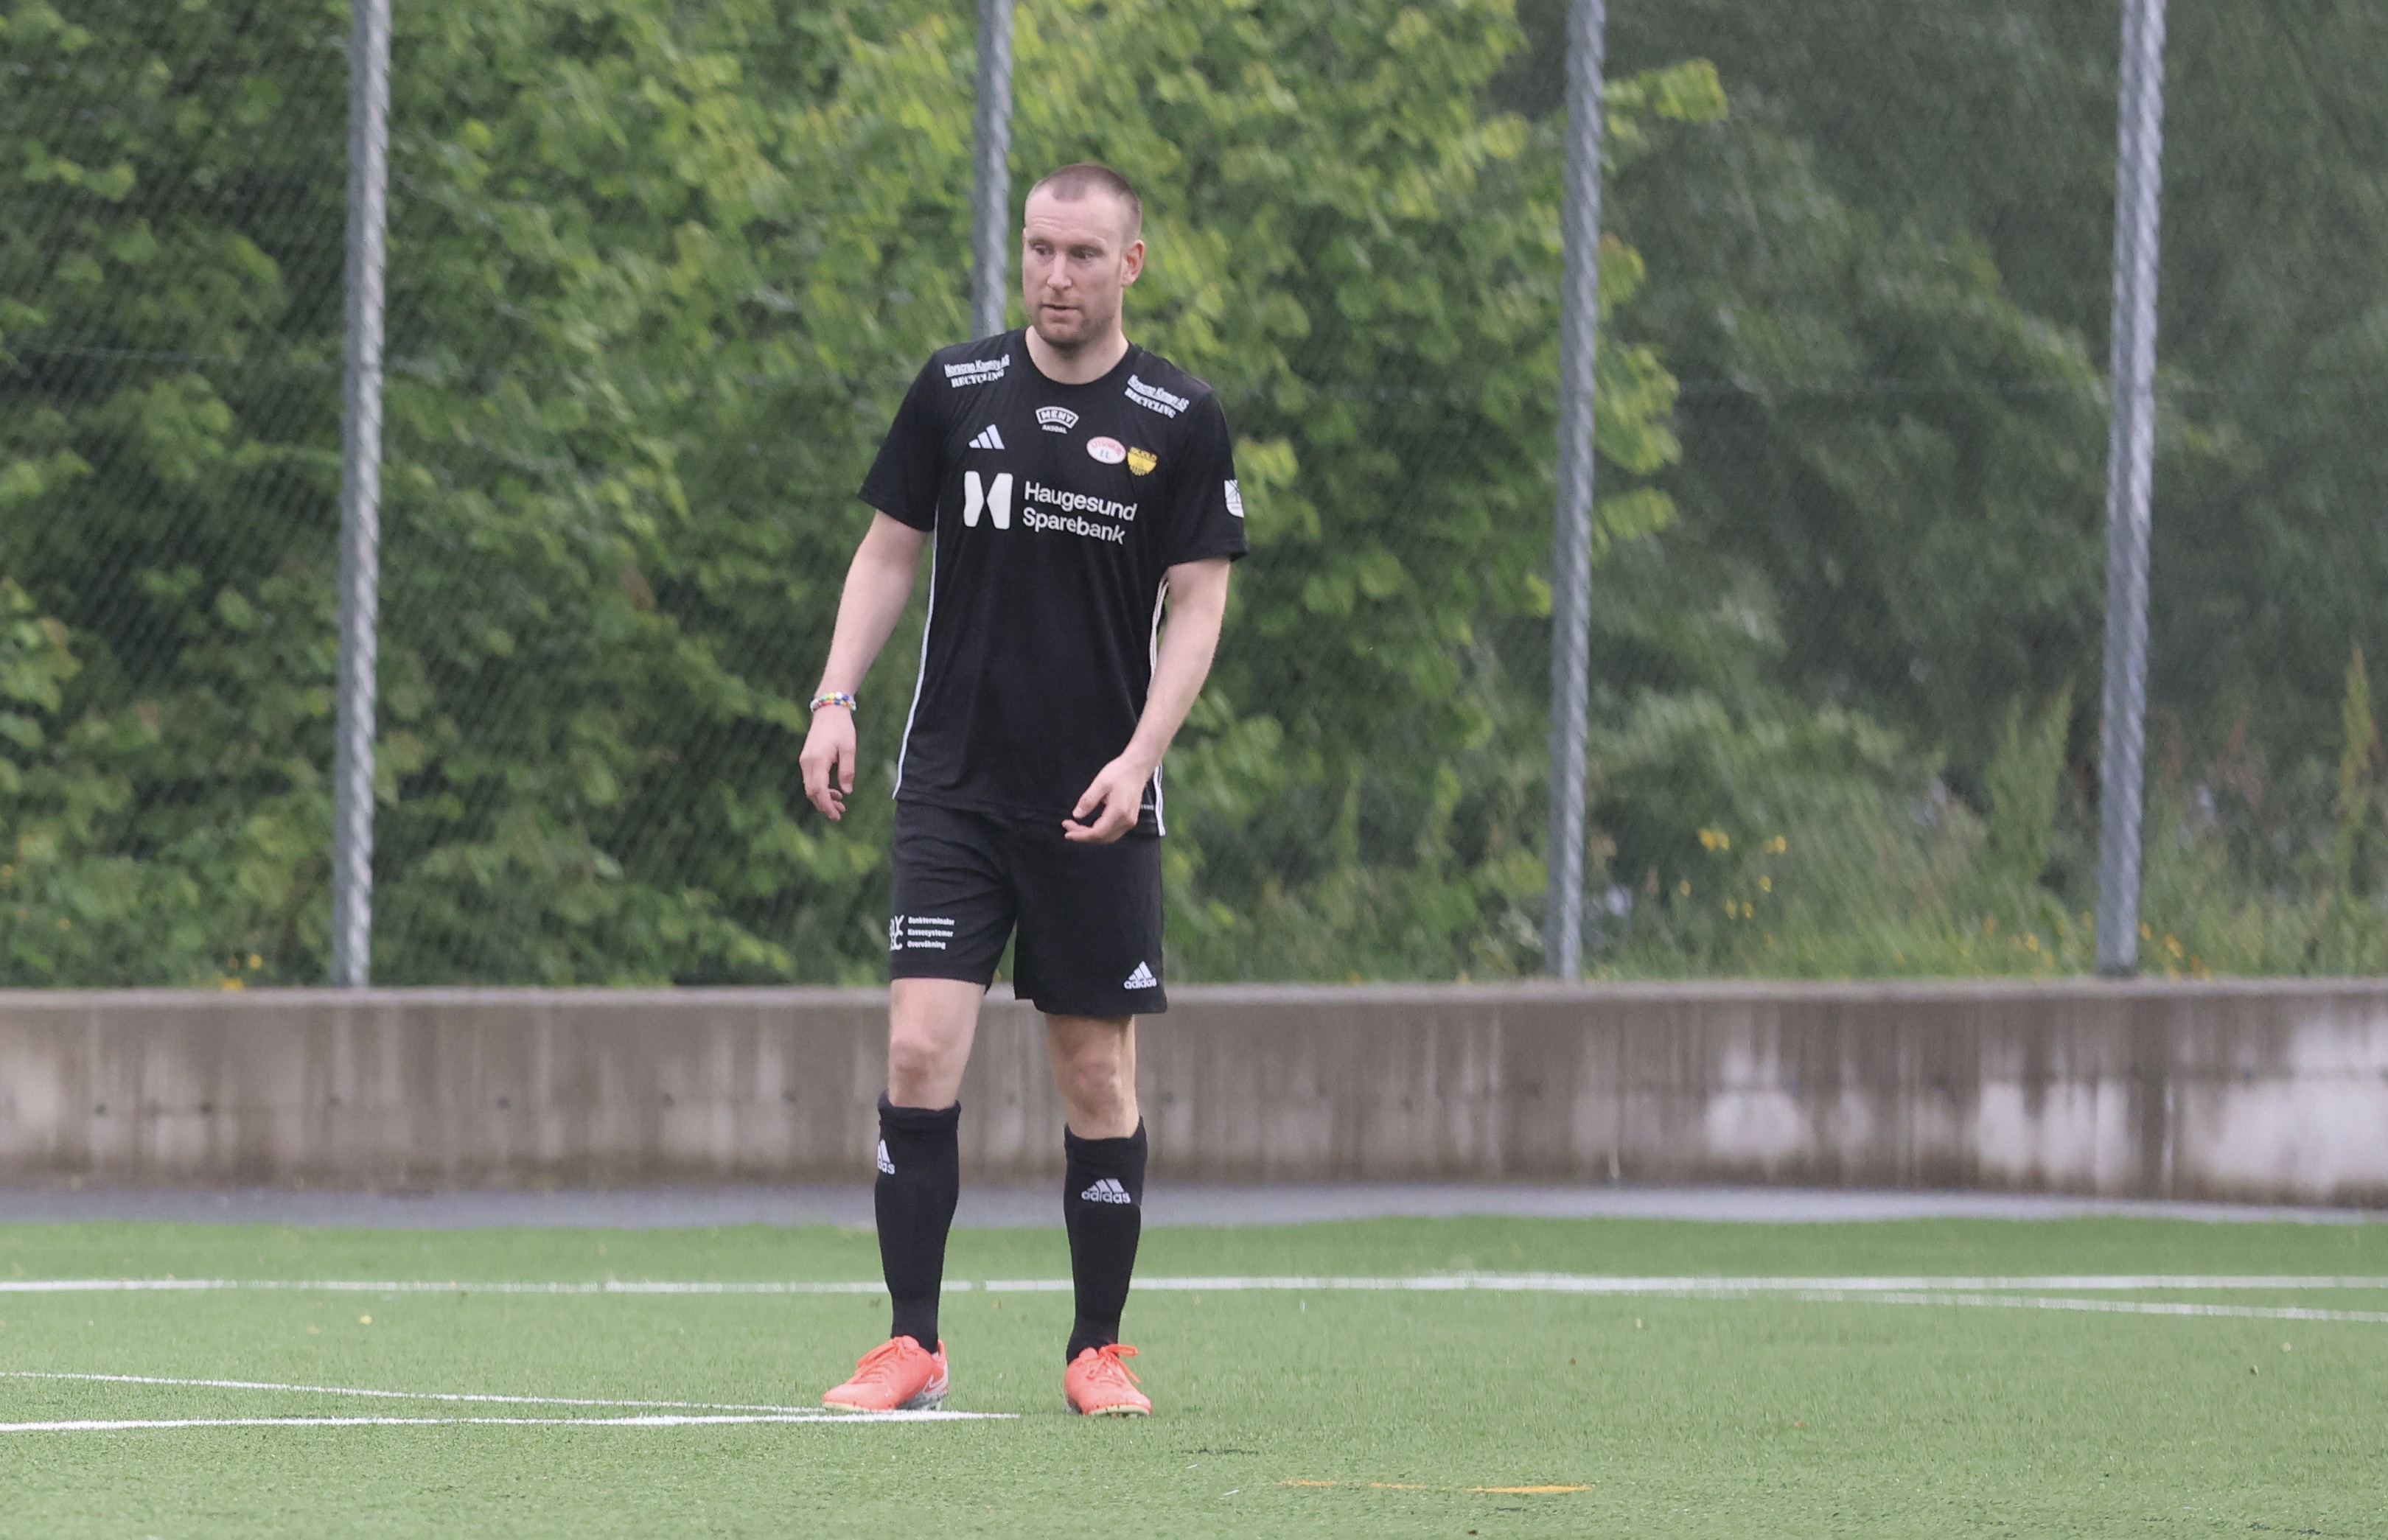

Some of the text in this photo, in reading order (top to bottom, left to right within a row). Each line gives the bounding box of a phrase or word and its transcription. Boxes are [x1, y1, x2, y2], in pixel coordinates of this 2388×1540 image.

[951, 368, 1005, 388] RECYCLING
[1124, 387, 1176, 419] RECYCLING
[1040, 410, 1075, 423] MENY
[1024, 480, 1138, 522] Haugesund
[1022, 506, 1126, 545] Sparebank
[908, 916, 955, 925] Bankterminaler
[907, 928, 953, 937] Kassesystemer
[1123, 977, 1157, 990] adidas
[1081, 1190, 1131, 1205] adidas
